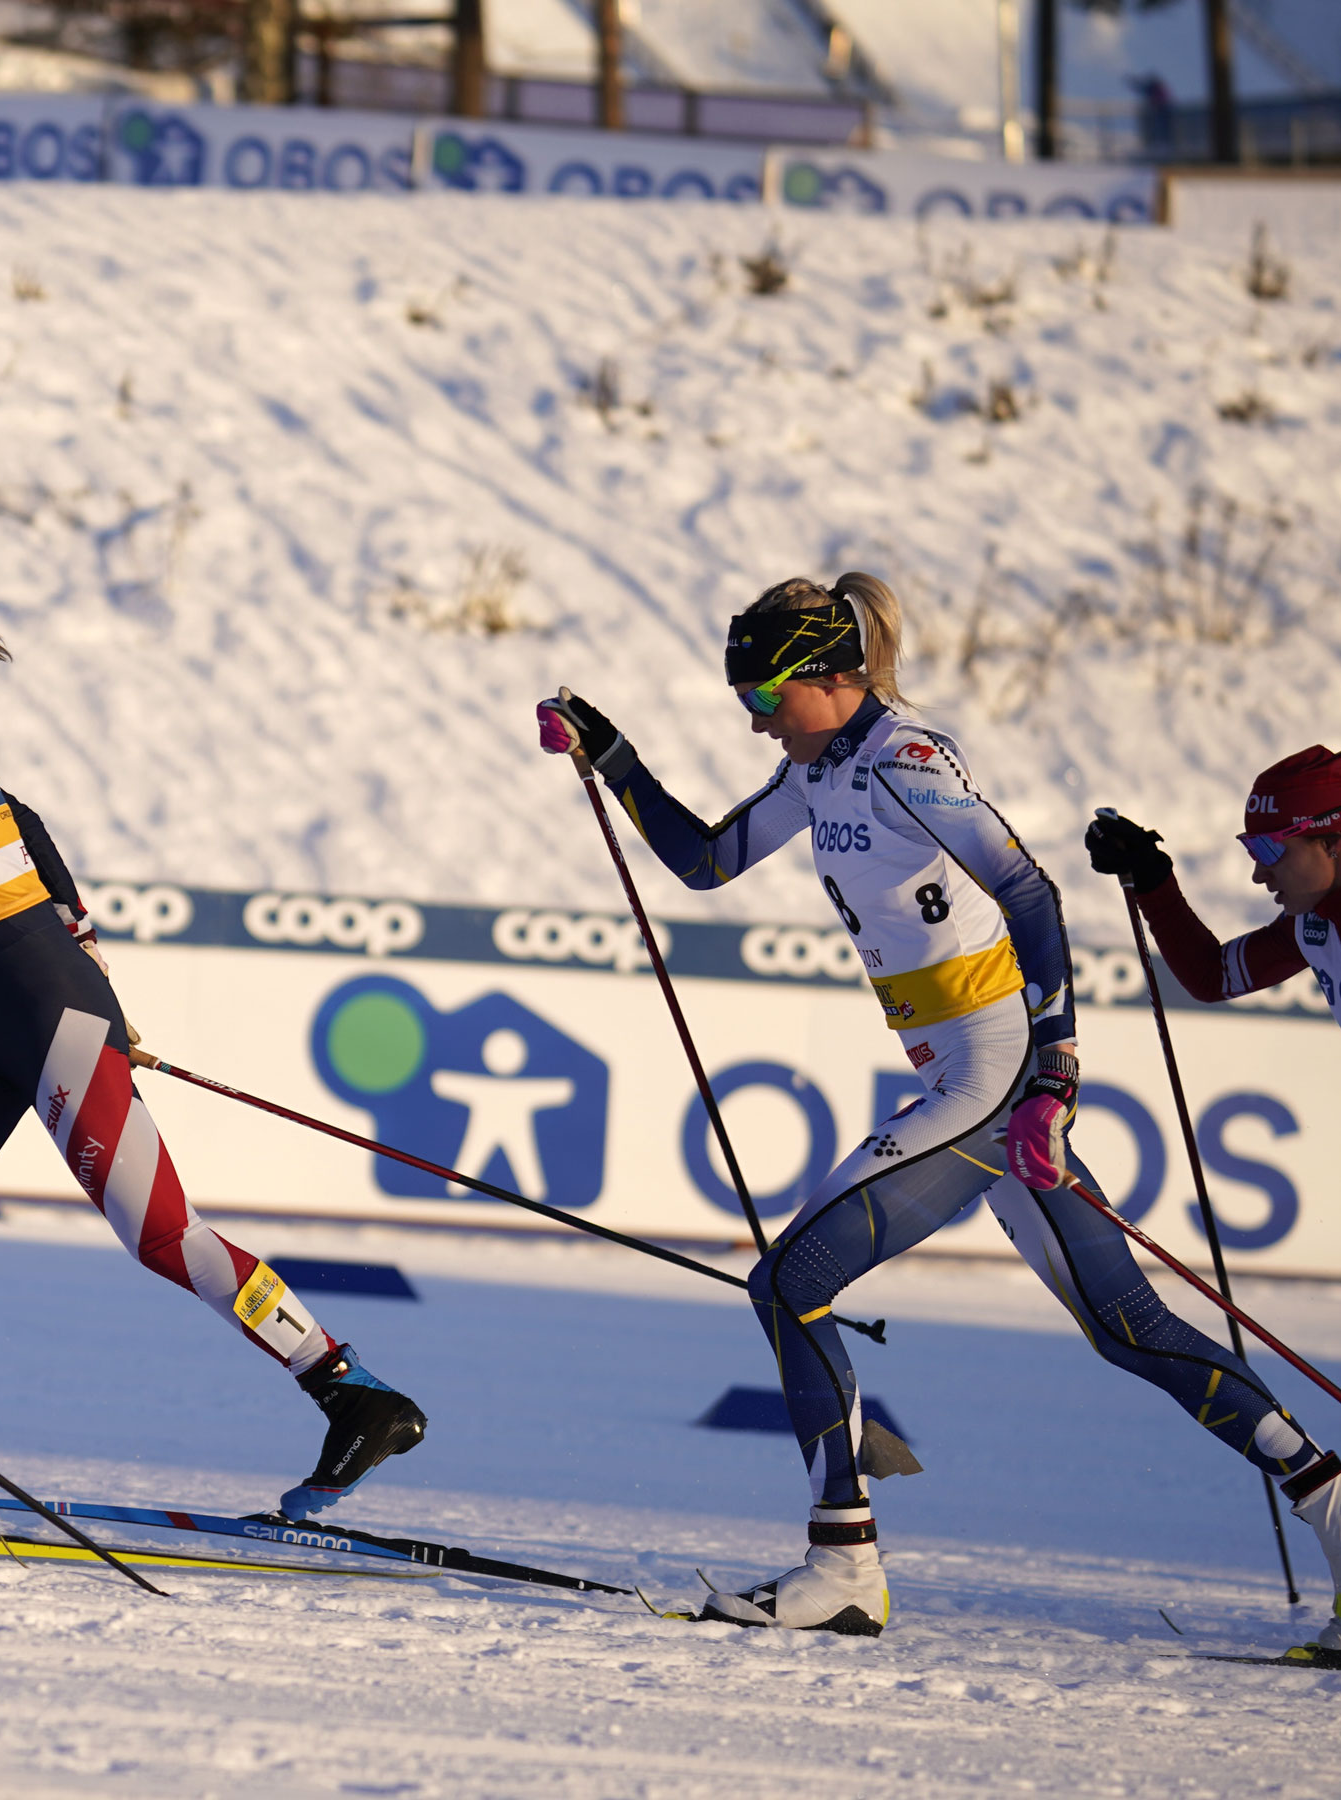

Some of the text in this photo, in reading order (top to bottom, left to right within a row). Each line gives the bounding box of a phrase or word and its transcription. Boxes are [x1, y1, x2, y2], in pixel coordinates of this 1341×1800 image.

[225, 136, 412, 192] OBOS
[877, 761, 942, 776] SVENSKA SPEL
[1246, 793, 1279, 814] OIL
[817, 819, 872, 853] OBOS
[823, 874, 862, 936] 8
[915, 882, 950, 925] 8
[242, 894, 425, 956] coop
[492, 909, 672, 973] coop
[1303, 928, 1327, 941] coop
[275, 1306, 307, 1335] 1
[243, 1525, 352, 1551] salomon
